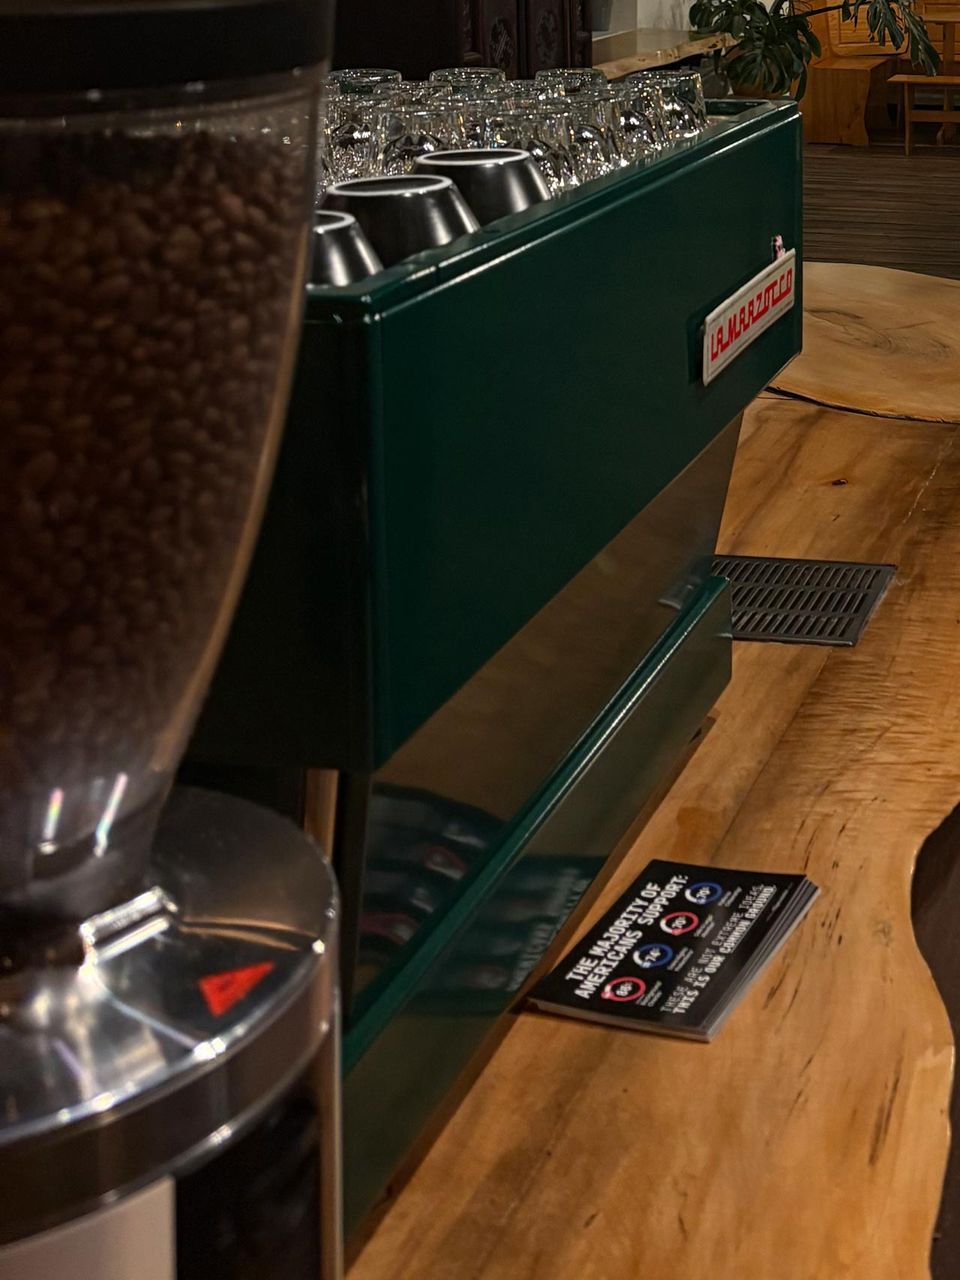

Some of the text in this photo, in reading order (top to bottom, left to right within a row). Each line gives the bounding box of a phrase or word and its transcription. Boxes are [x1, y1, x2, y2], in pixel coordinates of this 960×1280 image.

[565, 956, 597, 981] THE
[588, 897, 649, 957] MAJORITY
[640, 882, 661, 899] OF
[574, 929, 643, 999] AMERICANS
[637, 875, 689, 926] SUPPORT:
[660, 985, 690, 1012] THESE
[684, 966, 703, 983] ARE
[698, 947, 716, 964] NOT
[711, 912, 743, 946] EXTREME
[672, 989, 700, 1014] THIS
[692, 974, 711, 988] IS
[704, 955, 726, 974] OUR
[719, 919, 750, 954] COMMON
